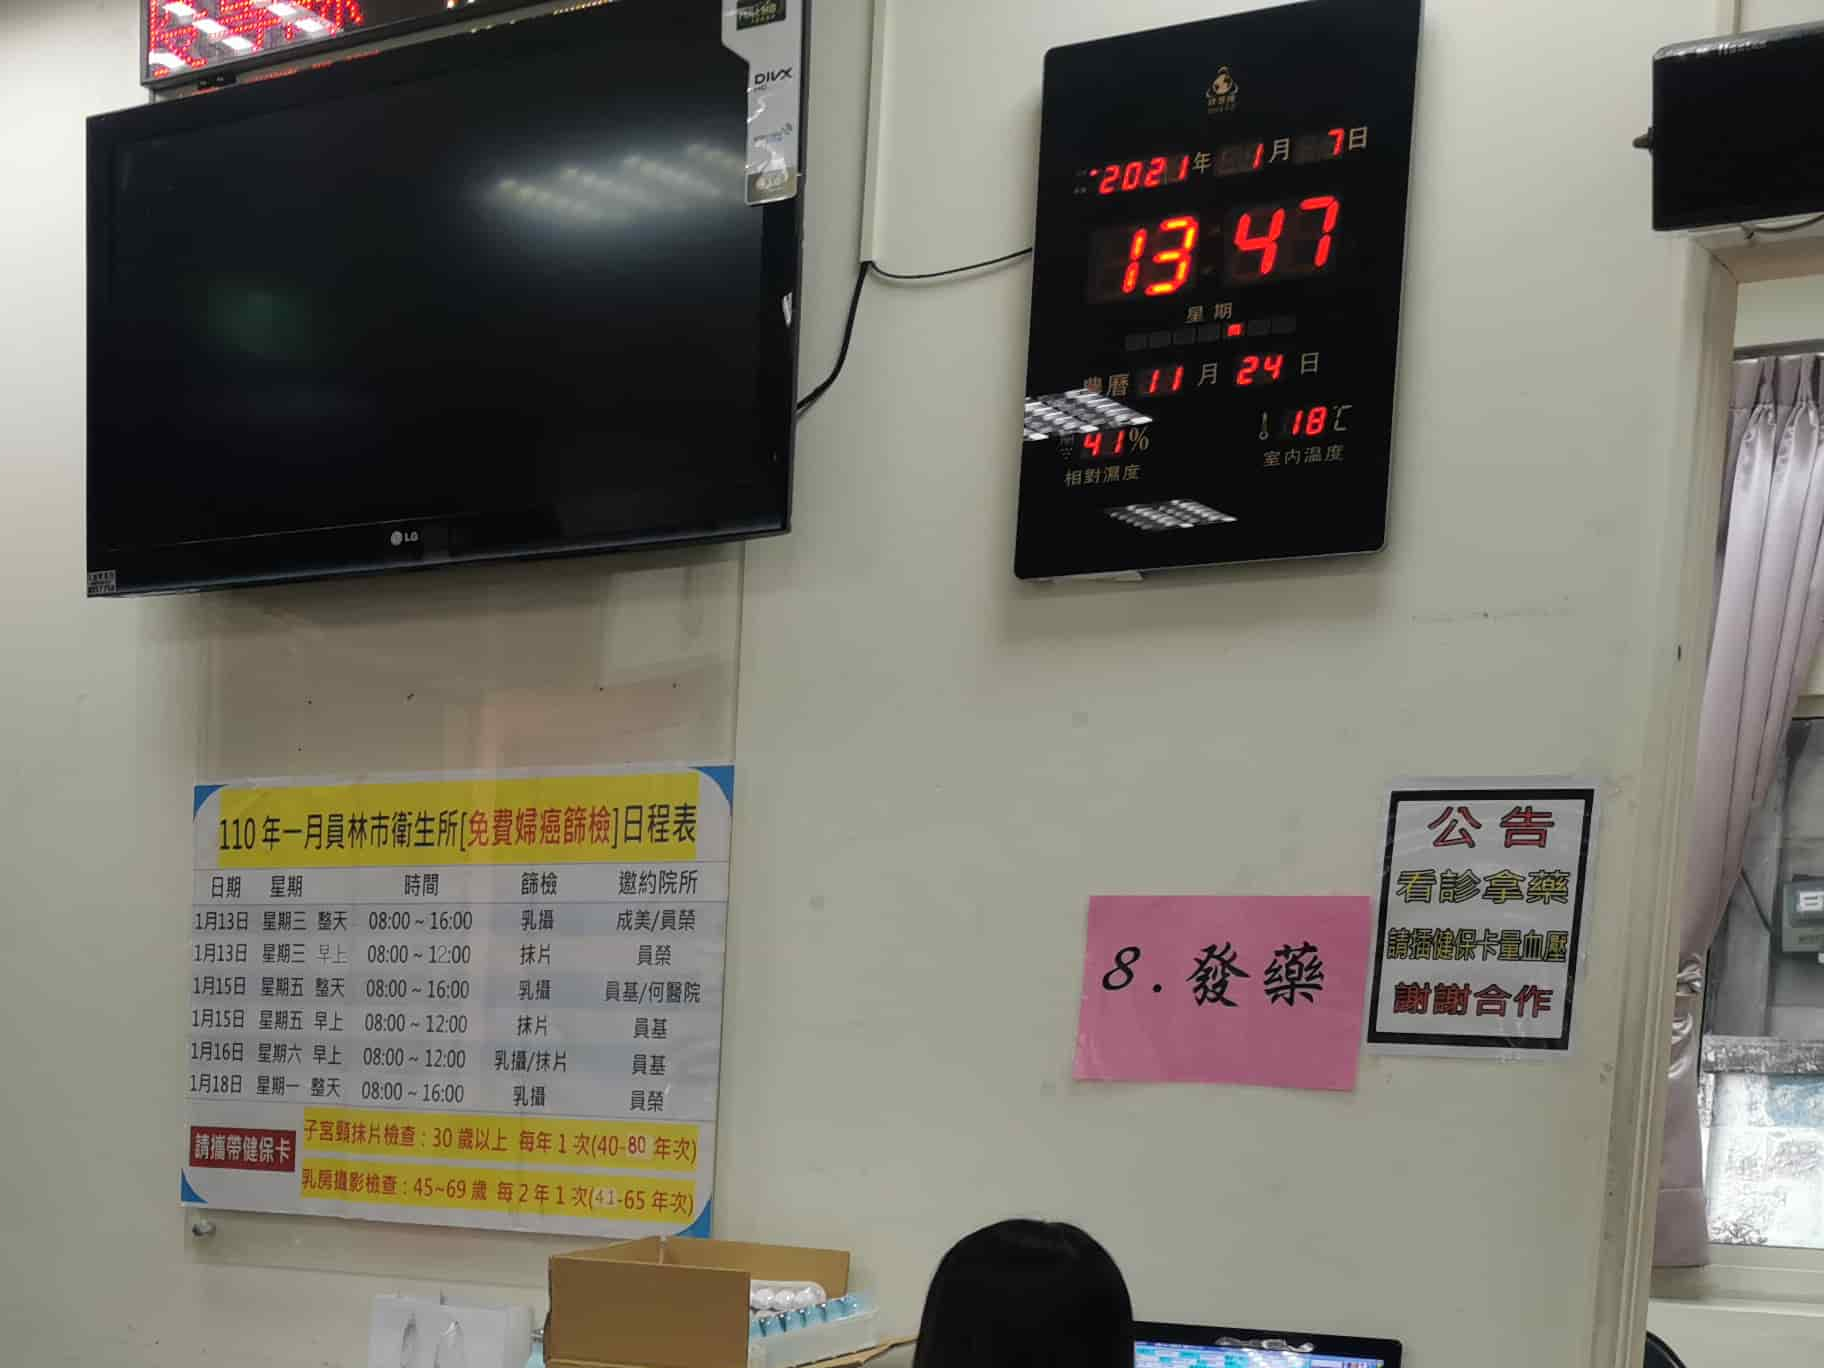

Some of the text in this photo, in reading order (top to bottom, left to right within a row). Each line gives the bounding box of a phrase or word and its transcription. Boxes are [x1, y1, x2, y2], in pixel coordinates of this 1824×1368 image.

[753, 67, 793, 86] DIVX
[1427, 805, 1555, 849] 公告
[210, 869, 699, 899] 日期 星期 時間 篩檢 邀約院所
[1395, 868, 1571, 905] 看診拿藥
[193, 911, 249, 931] 1月13日
[520, 909, 555, 931] 乳攝
[616, 908, 696, 933] 成美/員榮
[193, 943, 248, 963] 1月13日
[519, 943, 552, 966] 抹片
[636, 944, 672, 967] 員榮
[1385, 926, 1570, 963] 請插健保卡量血壓
[192, 976, 246, 996] 1月15日
[518, 979, 552, 1001] 乳攝
[604, 980, 702, 1004] 員基/何醫院
[1392, 981, 1555, 1018] 謝謝合作
[191, 1008, 245, 1028] 1月15日
[516, 1014, 549, 1036] 抹片
[632, 1017, 668, 1039] 員基
[190, 1041, 244, 1062] 1月16日
[494, 1049, 568, 1073] 乳攝/抹片
[631, 1054, 667, 1076] 員基
[189, 1073, 243, 1094] 1月18日
[512, 1085, 546, 1108] 乳攝
[629, 1089, 665, 1113] 員榮
[193, 1131, 292, 1164] 請攜帶健保卡
